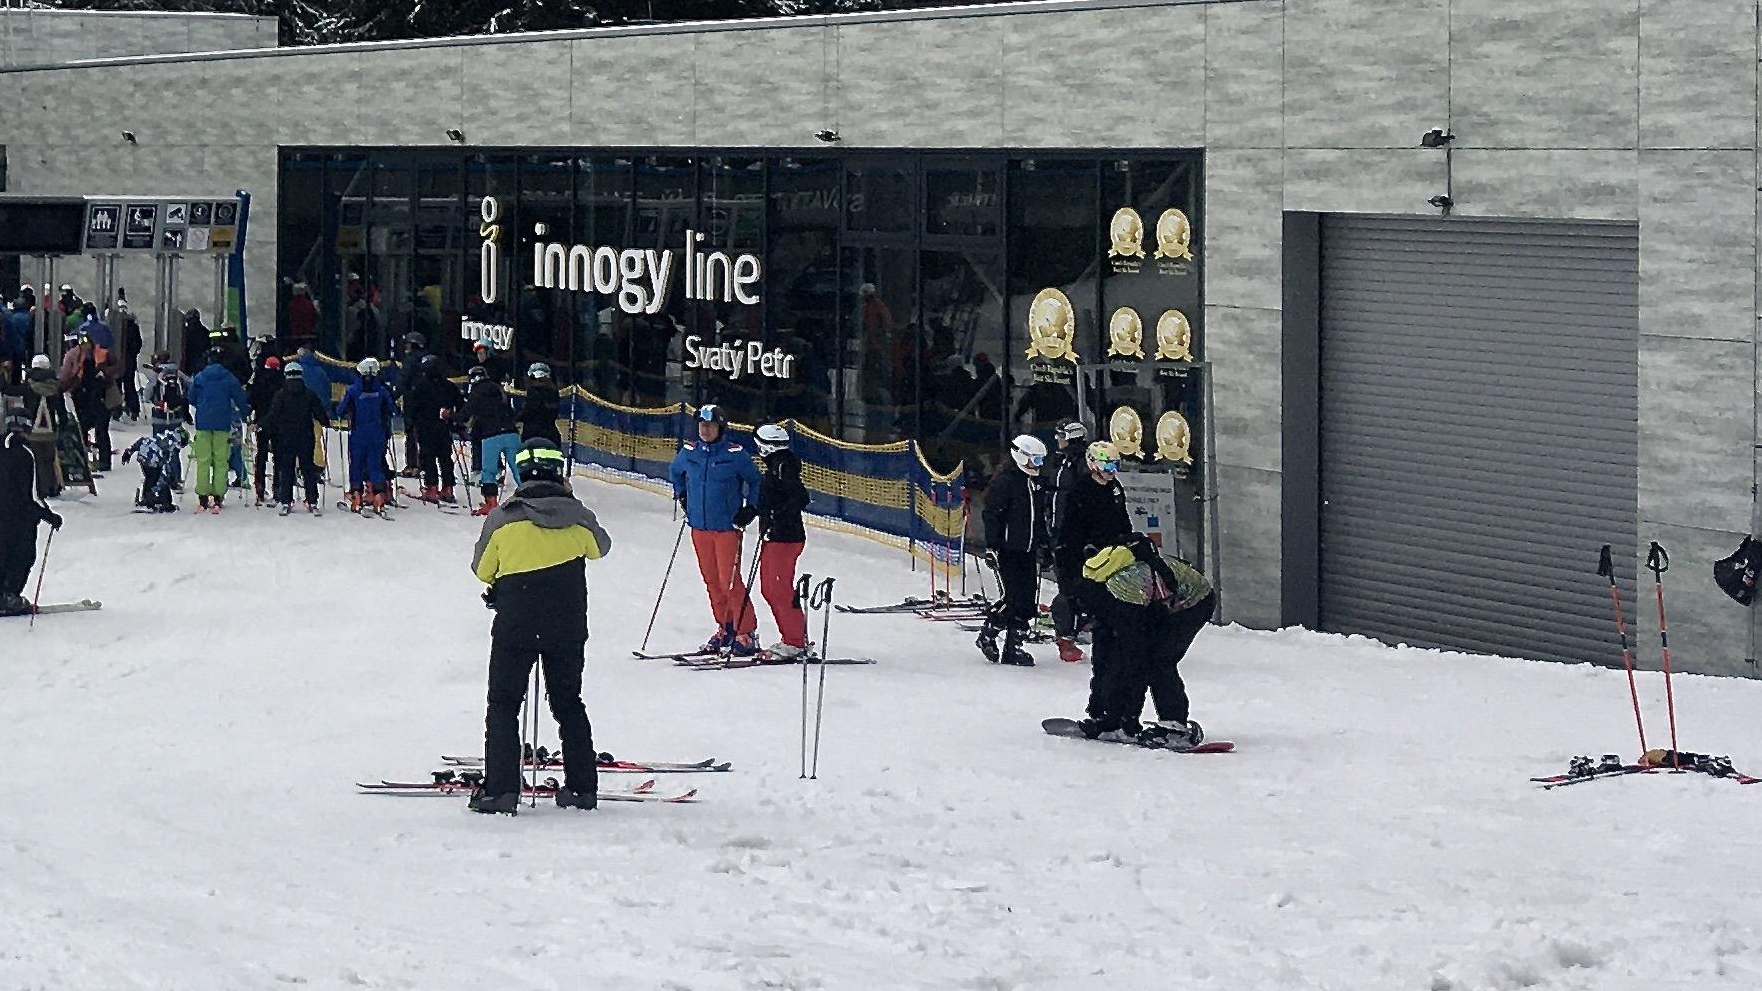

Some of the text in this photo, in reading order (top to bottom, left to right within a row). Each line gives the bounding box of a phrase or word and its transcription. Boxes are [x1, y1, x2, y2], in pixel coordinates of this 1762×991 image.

[534, 222, 762, 315] innogy line
[461, 315, 515, 350] innogy
[685, 335, 794, 380] Svatý Petr
